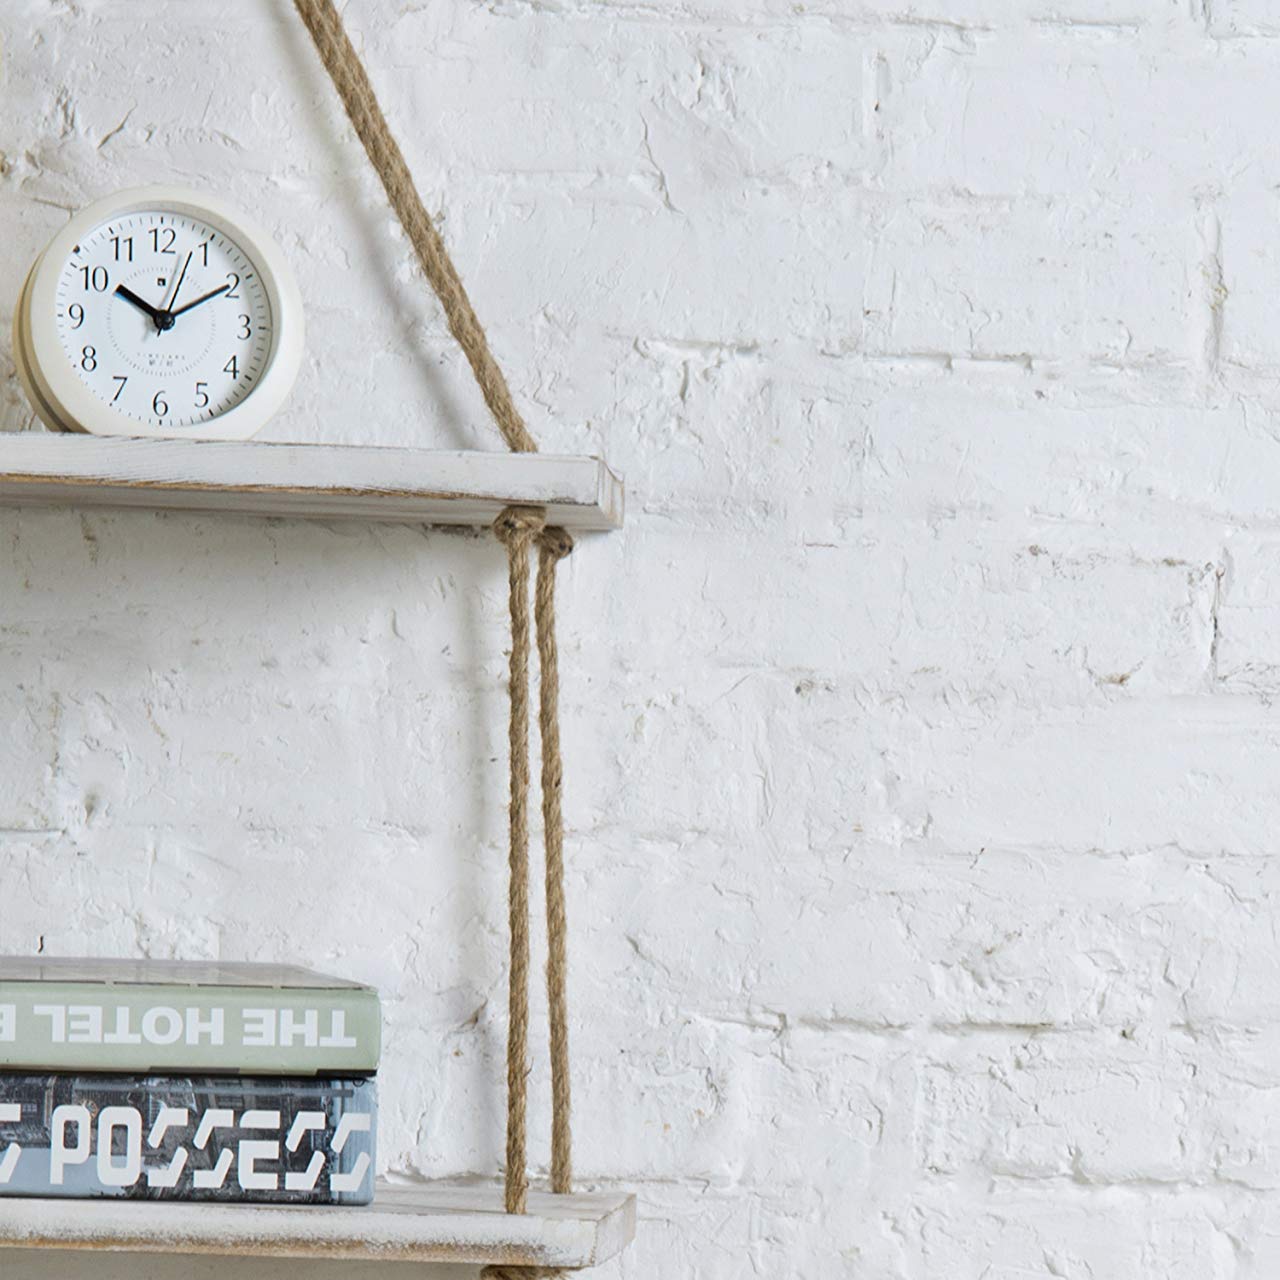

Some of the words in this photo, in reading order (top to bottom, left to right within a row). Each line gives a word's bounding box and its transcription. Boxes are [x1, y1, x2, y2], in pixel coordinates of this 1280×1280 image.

[110, 236, 133, 262] 11
[149, 228, 176, 254] 12
[198, 242, 208, 266] 1
[80, 265, 108, 292] 10
[224, 273, 240, 298] 2
[69, 304, 85, 329] 9
[237, 314, 251, 340] 3
[81, 346, 97, 371] 8
[223, 355, 240, 380] 4
[113, 376, 128, 402] 7
[194, 383, 209, 408] 5
[153, 390, 168, 416] 6
[33, 1004, 225, 1046] HOTEL
[242, 1008, 357, 1048] THE
[49, 1104, 371, 1192] POSSESS
